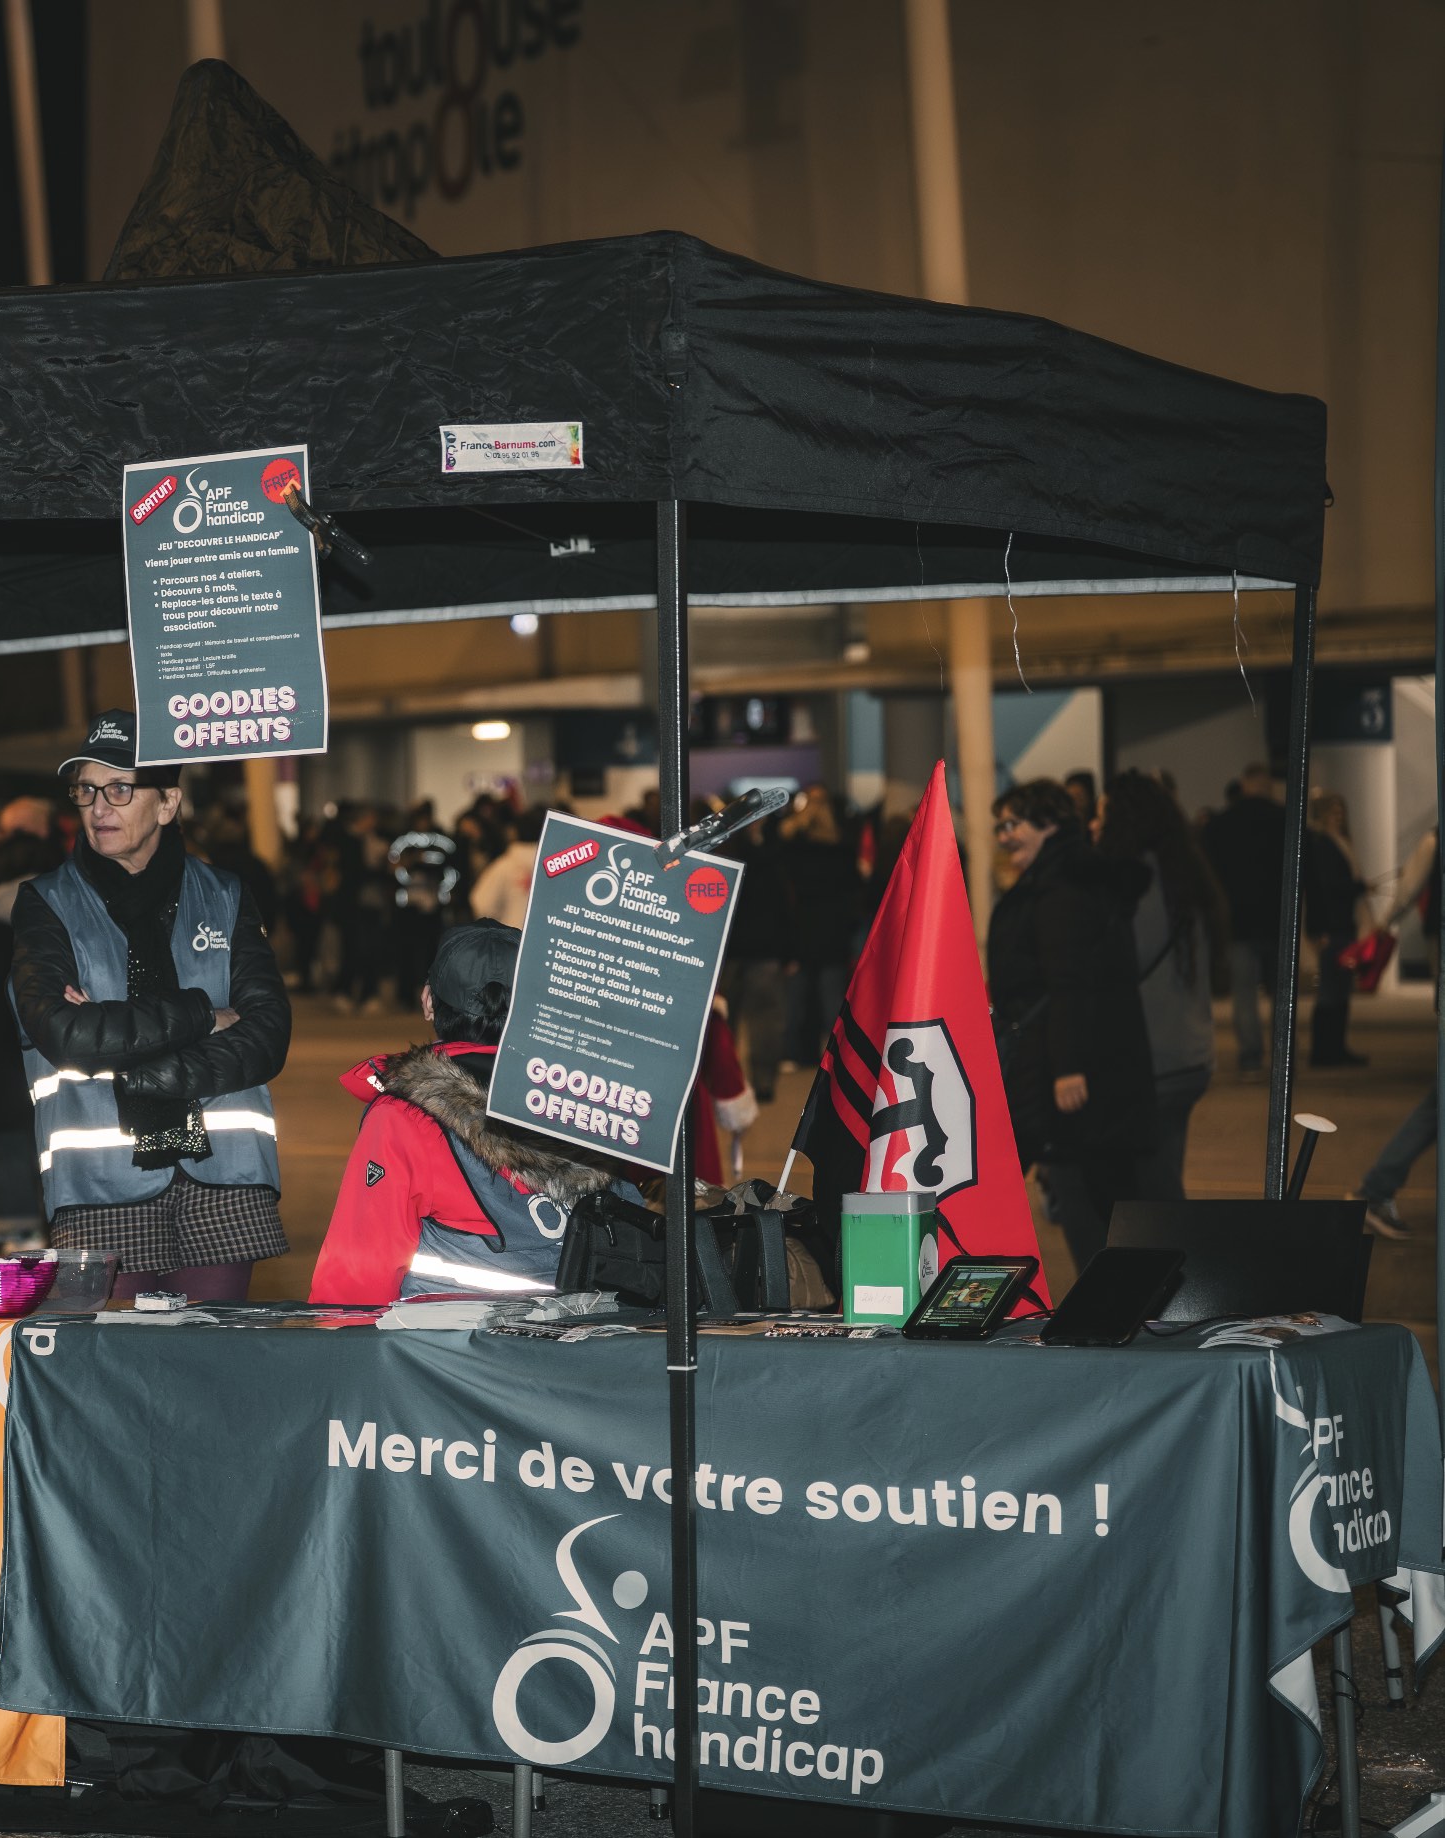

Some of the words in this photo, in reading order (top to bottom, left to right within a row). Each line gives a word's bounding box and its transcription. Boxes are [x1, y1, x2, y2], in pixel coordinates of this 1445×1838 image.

[133, 479, 172, 520] GRATUIT
[205, 486, 232, 502] APF
[205, 500, 249, 514] France
[206, 510, 265, 526] handicap
[144, 558, 169, 568] Viens
[169, 556, 193, 568] jouer
[193, 554, 218, 563] entre
[218, 550, 242, 561] amis
[242, 551, 254, 559] ou
[255, 549, 267, 558] en
[267, 545, 300, 556] famille
[157, 542, 173, 551] JEU
[224, 535, 234, 545] LE
[160, 575, 199, 586] Parcours
[200, 573, 217, 582] nos
[219, 571, 226, 580] 4
[227, 569, 263, 580] ateliers,
[160, 587, 203, 598] Découvre
[204, 584, 211, 593] 6
[212, 583, 238, 593] mots,
[161, 597, 215, 611] Replace-les
[216, 595, 239, 604] dans
[240, 593, 250, 602] le
[251, 591, 274, 601] texte
[275, 589, 282, 599] à
[162, 608, 186, 621] trous
[187, 610, 209, 621] pour
[210, 604, 253, 616] découvrir
[254, 603, 279, 613] notre
[163, 620, 217, 632] association.
[168, 686, 295, 718] GOODIES
[174, 716, 291, 747] OFFERTS
[546, 842, 594, 873] GRATUIT
[624, 868, 655, 887] APF
[688, 882, 725, 899] FREE
[618, 894, 681, 924] handicap
[621, 882, 668, 906] France
[563, 904, 580, 915] JEU
[631, 923, 643, 934] LE
[209, 936, 228, 944] Franc
[547, 915, 572, 930] Viens
[571, 922, 597, 937] jouer
[596, 931, 622, 944] entre
[621, 938, 645, 951] amis
[645, 945, 659, 955] ou
[659, 949, 672, 959] en
[672, 951, 705, 968] famille
[554, 950, 597, 970] Découvre
[598, 962, 605, 972] 6
[606, 966, 632, 981] mots,
[556, 938, 597, 957] Parcours
[597, 951, 615, 963] nos
[616, 956, 624, 965] 4
[624, 959, 661, 977] ateliers,
[547, 986, 601, 1008] association.
[550, 973, 573, 988] trous
[573, 982, 597, 998] pour
[597, 988, 641, 1008] découvrir
[641, 1002, 667, 1015] notre
[552, 962, 605, 985] Replace-les
[606, 974, 631, 992] dans
[631, 984, 641, 995] le
[642, 988, 665, 1002] texte
[666, 995, 674, 1004] à
[526, 1058, 651, 1116] GOODIES
[525, 1089, 639, 1144] OFFERTS
[1307, 1414, 1344, 1460] PF
[328, 1420, 496, 1482] Merci
[518, 1442, 594, 1493] de
[806, 1476, 1062, 1534] soutien
[1094, 1483, 1111, 1537] !
[1319, 1466, 1374, 1507] ance
